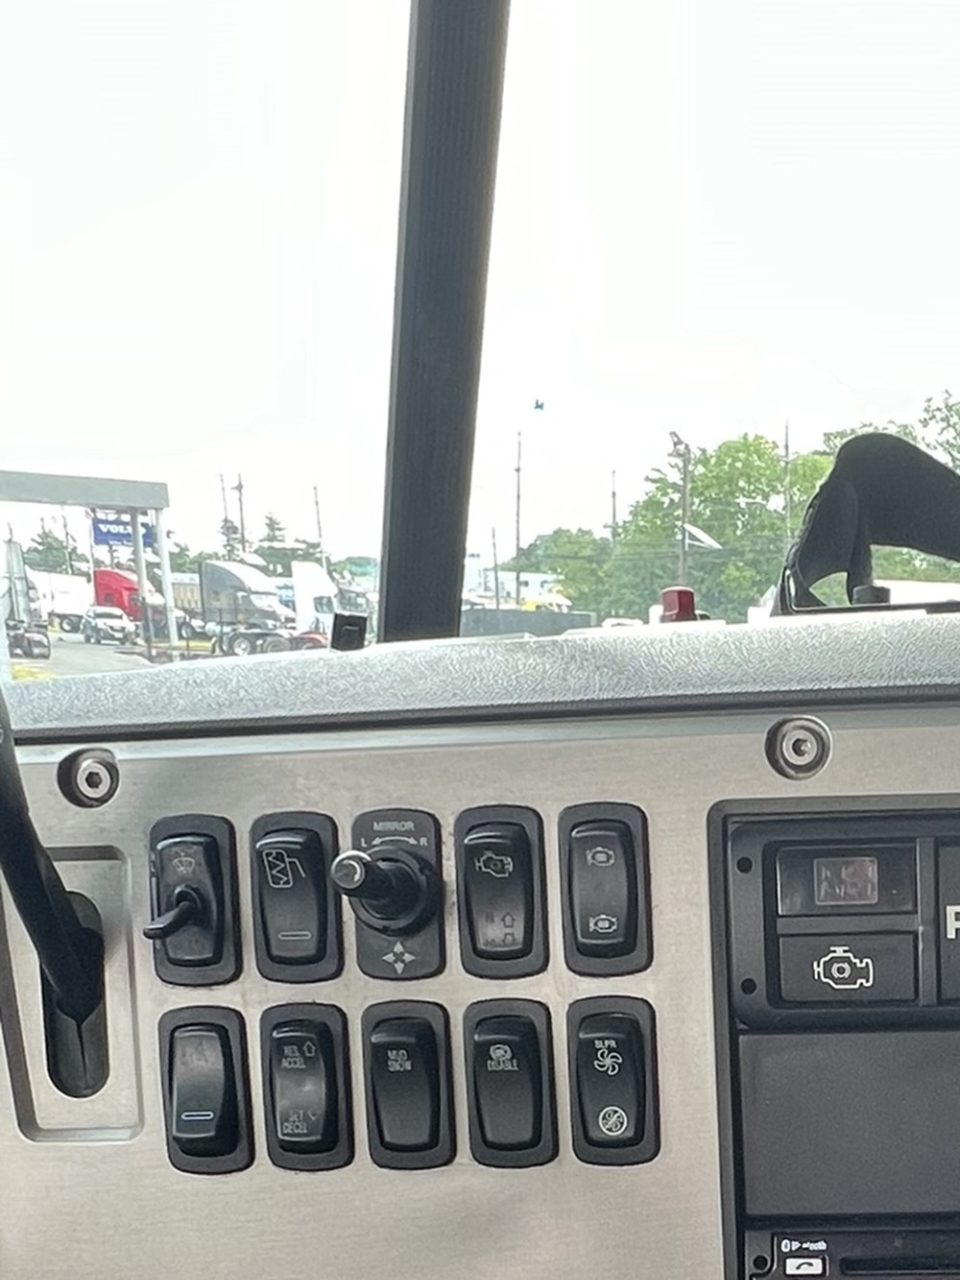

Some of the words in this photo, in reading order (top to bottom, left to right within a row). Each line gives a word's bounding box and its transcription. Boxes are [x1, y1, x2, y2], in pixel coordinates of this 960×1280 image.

[98, 523, 146, 534] VOL
[373, 821, 415, 831] MIRROR
[361, 837, 368, 847] L
[420, 836, 428, 846] R
